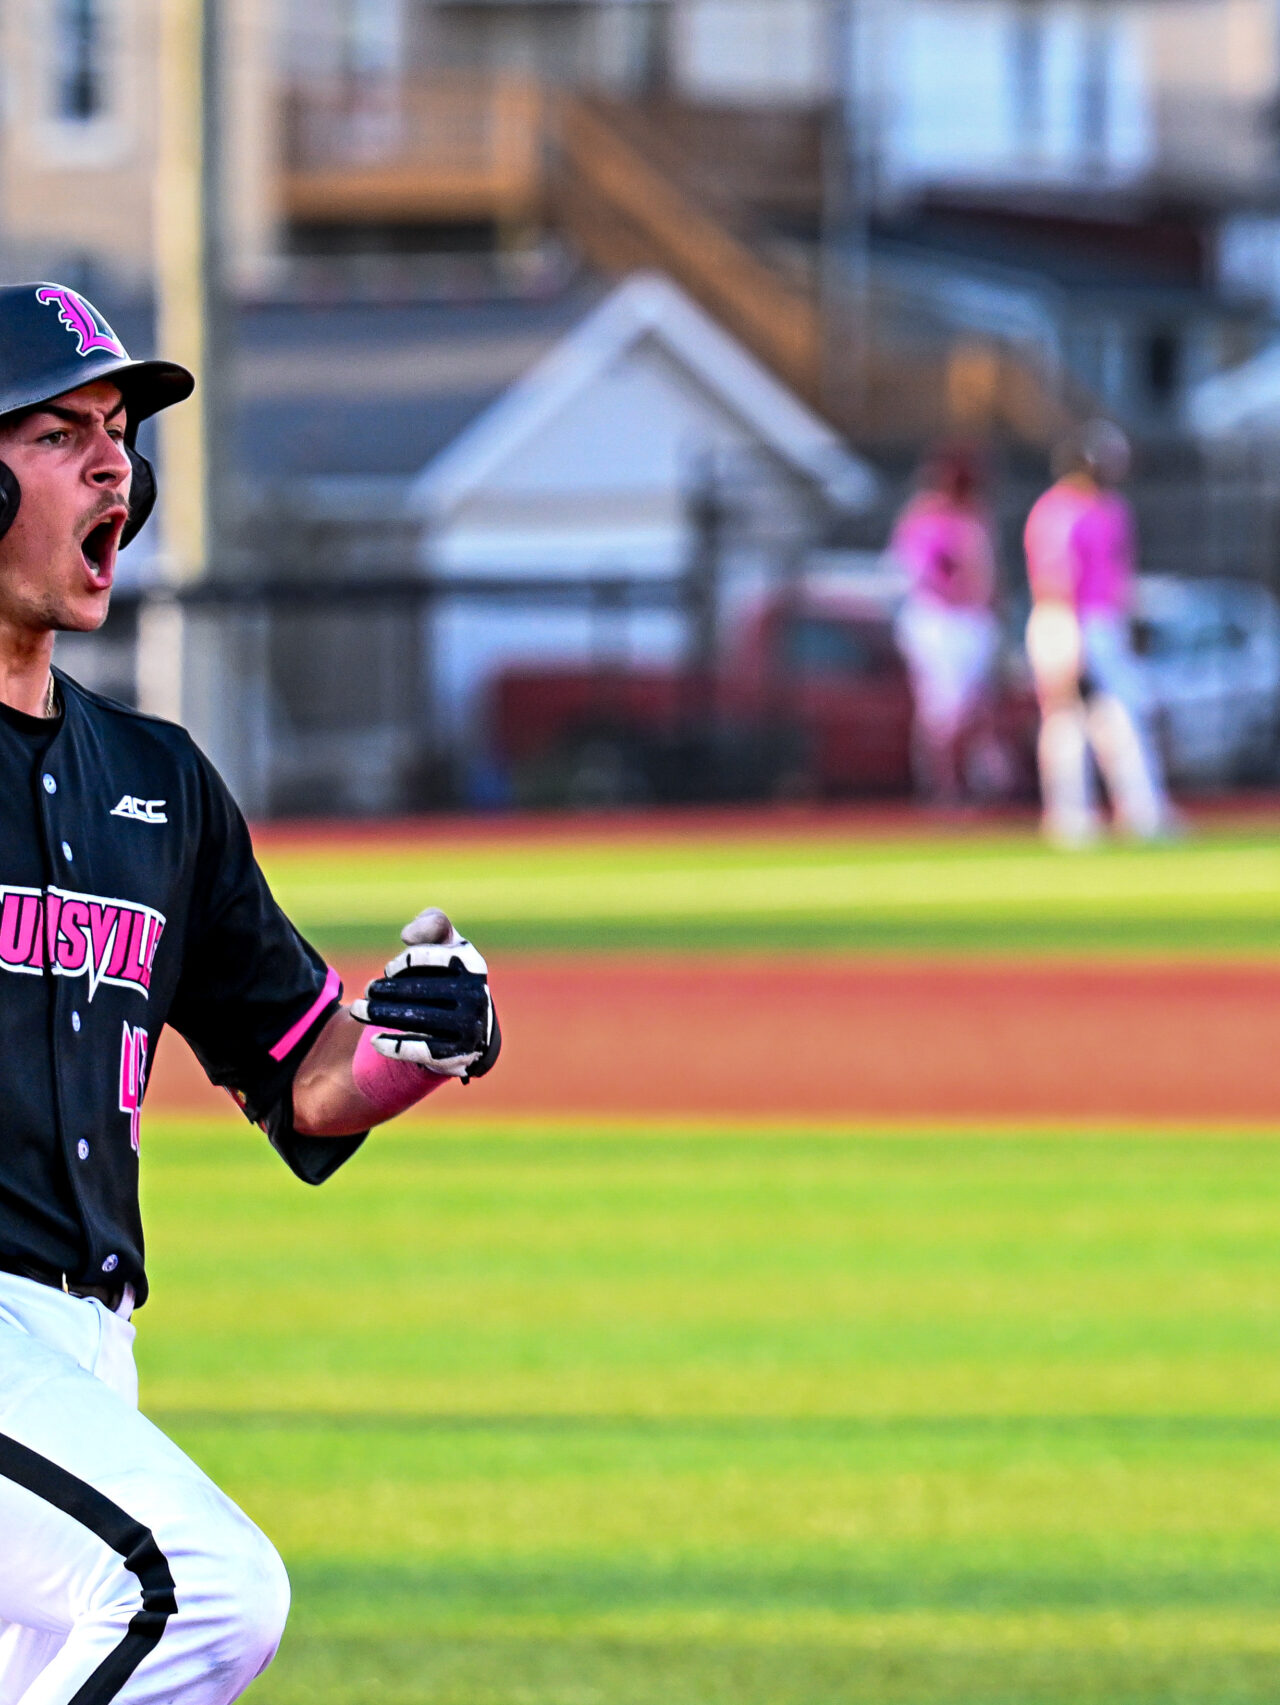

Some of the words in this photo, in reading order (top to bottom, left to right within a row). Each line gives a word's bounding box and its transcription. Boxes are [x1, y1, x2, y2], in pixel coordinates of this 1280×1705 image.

[36, 286, 126, 359] L
[110, 795, 168, 824] ACC
[119, 1020, 148, 1157] 4
